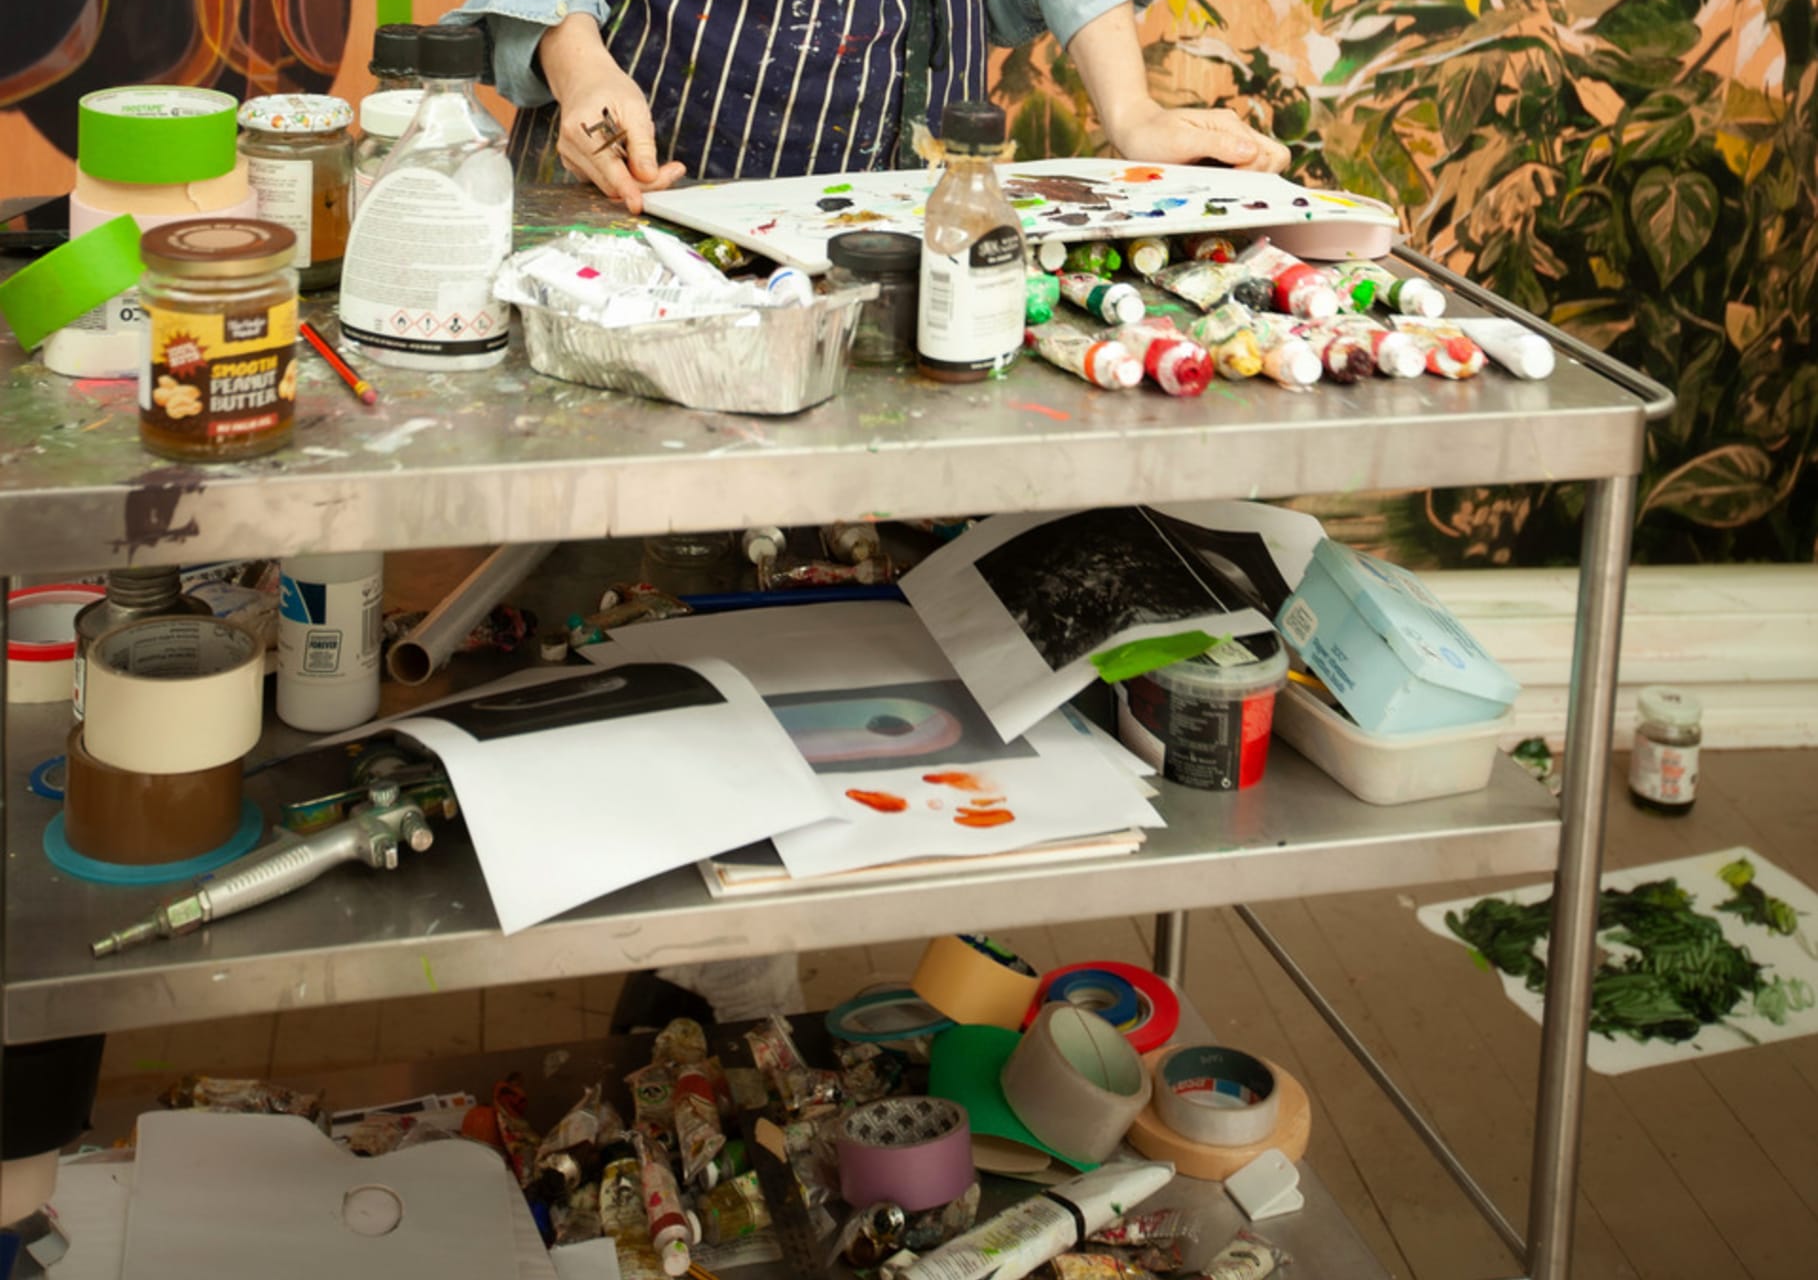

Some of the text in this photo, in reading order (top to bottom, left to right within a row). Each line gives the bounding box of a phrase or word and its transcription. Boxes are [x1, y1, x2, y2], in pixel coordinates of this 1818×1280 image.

[211, 355, 278, 378] SMOOTH
[210, 371, 277, 396] PEANUT
[210, 388, 277, 412] BUTTER
